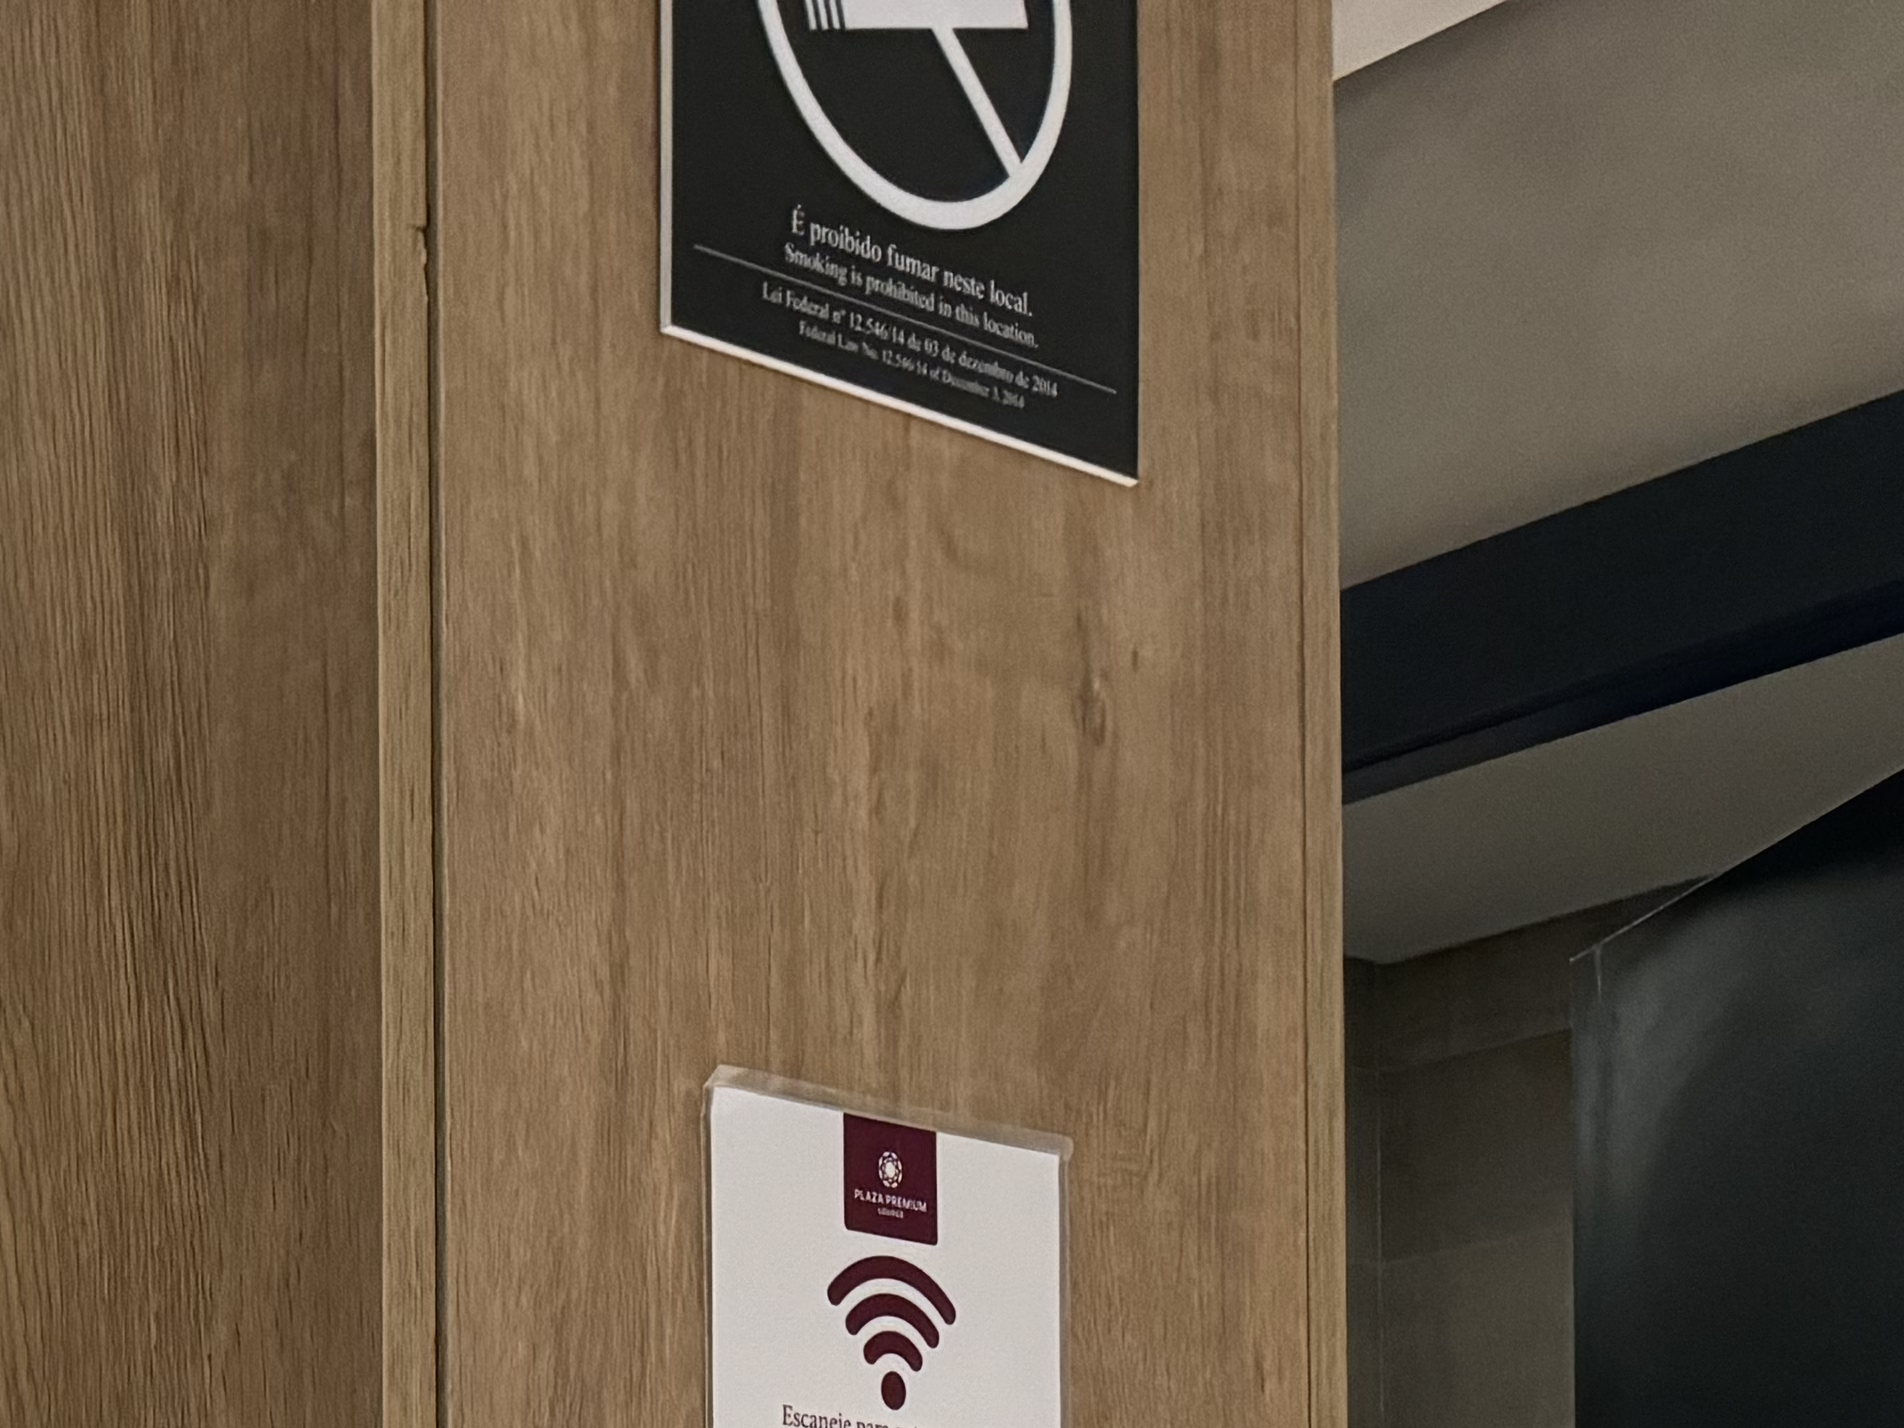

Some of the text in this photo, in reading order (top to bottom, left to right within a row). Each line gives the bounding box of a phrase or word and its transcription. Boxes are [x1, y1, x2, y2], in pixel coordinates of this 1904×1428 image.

[784, 242, 1039, 349] Smoking is prohibited in this location.
[792, 204, 1032, 316] É proibido fumar neste local.
[762, 281, 782, 303] Lei
[786, 290, 829, 319] Federal
[907, 332, 921, 352] de
[942, 344, 956, 364] de
[958, 351, 1014, 384] dezembro
[1015, 370, 1030, 388] de
[1032, 375, 1058, 398] 2014
[854, 1188, 927, 1212] PLAZA PREMIUM
